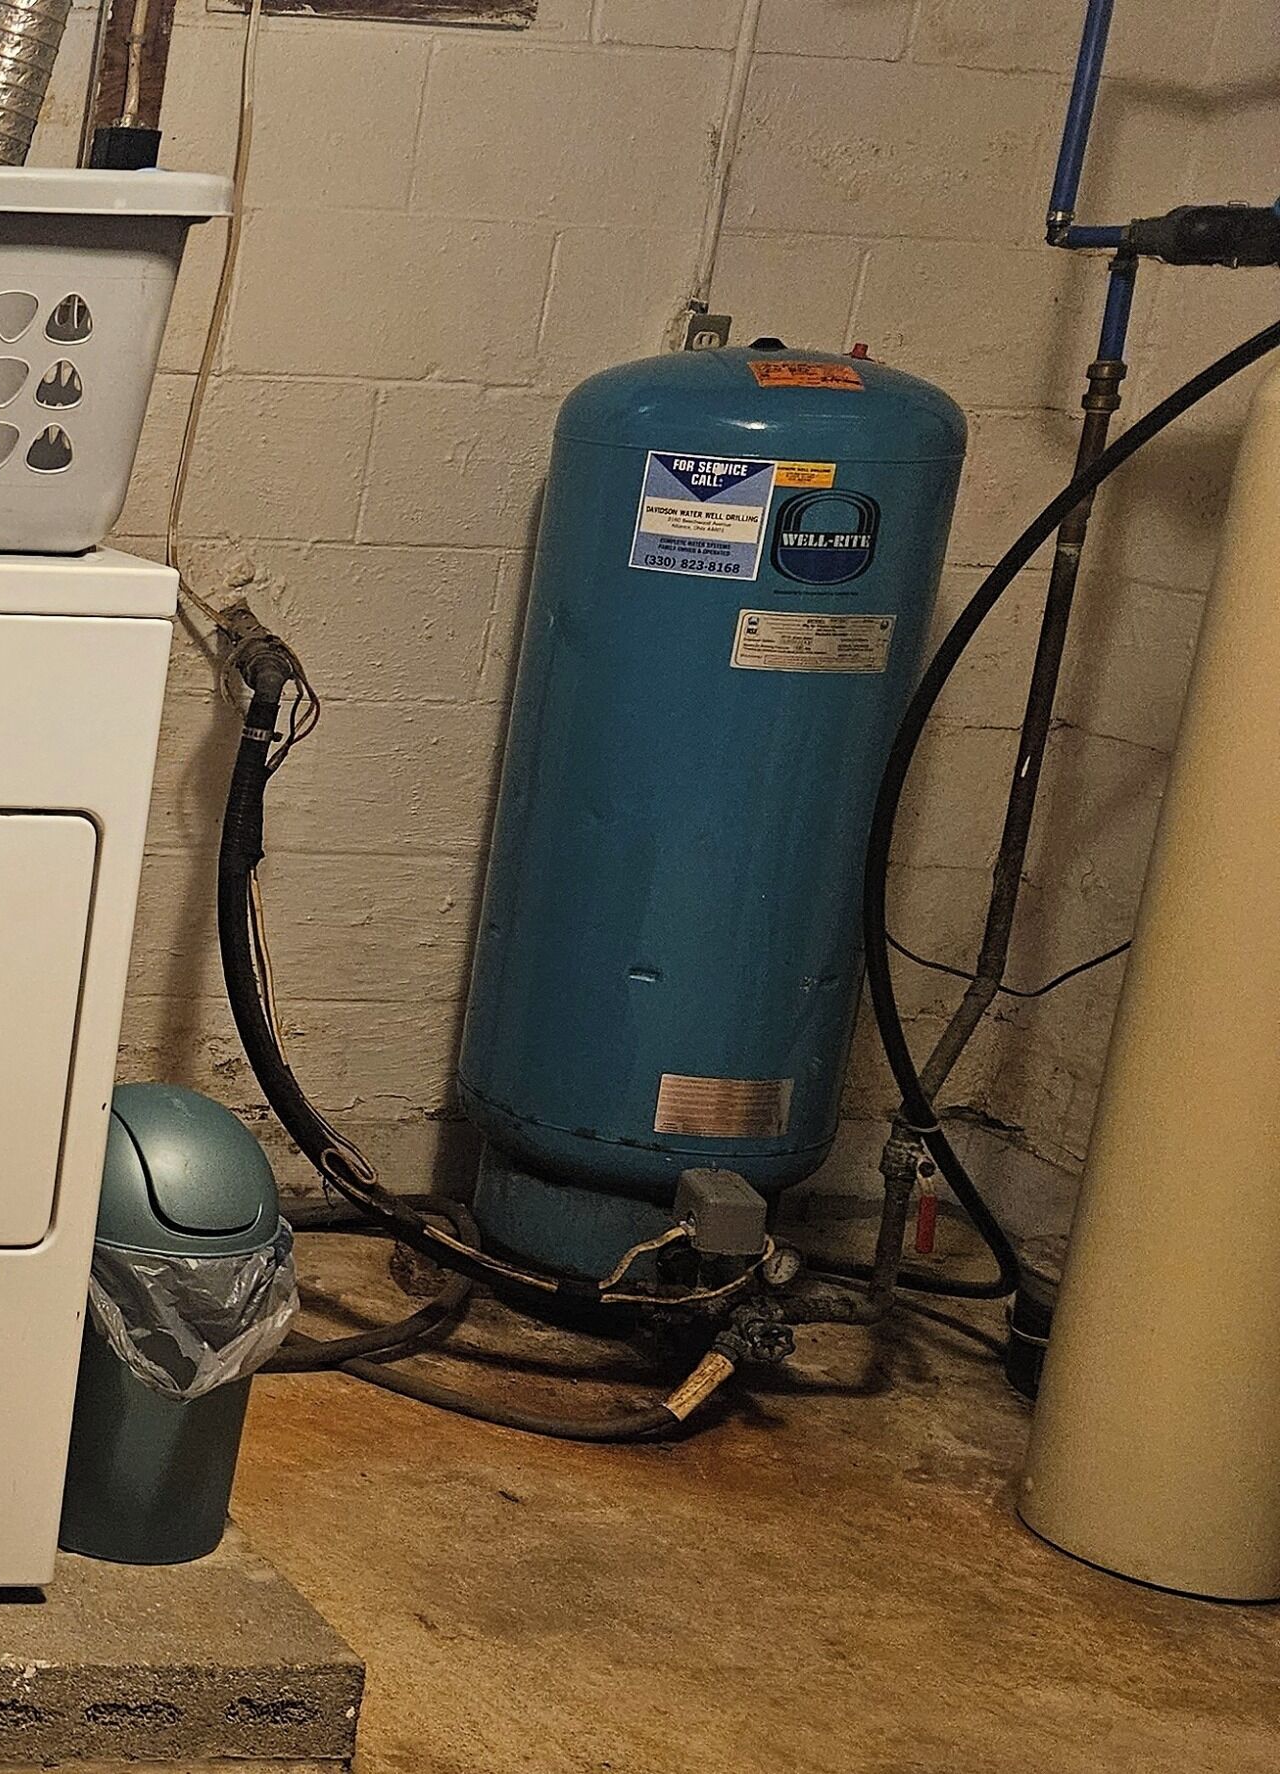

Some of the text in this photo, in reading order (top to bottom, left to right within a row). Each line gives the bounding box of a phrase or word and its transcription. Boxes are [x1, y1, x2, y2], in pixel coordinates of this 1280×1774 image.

[673, 459, 695, 472] FOR
[691, 474, 723, 487] CALL:
[646, 506, 759, 523] DAVIDSON WATER WELL DRILLING
[682, 518, 712, 526] Beechwood
[782, 533, 871, 548] WELL-RITE
[702, 548, 731, 556] OPERATED
[644, 554, 677, 569] (330)
